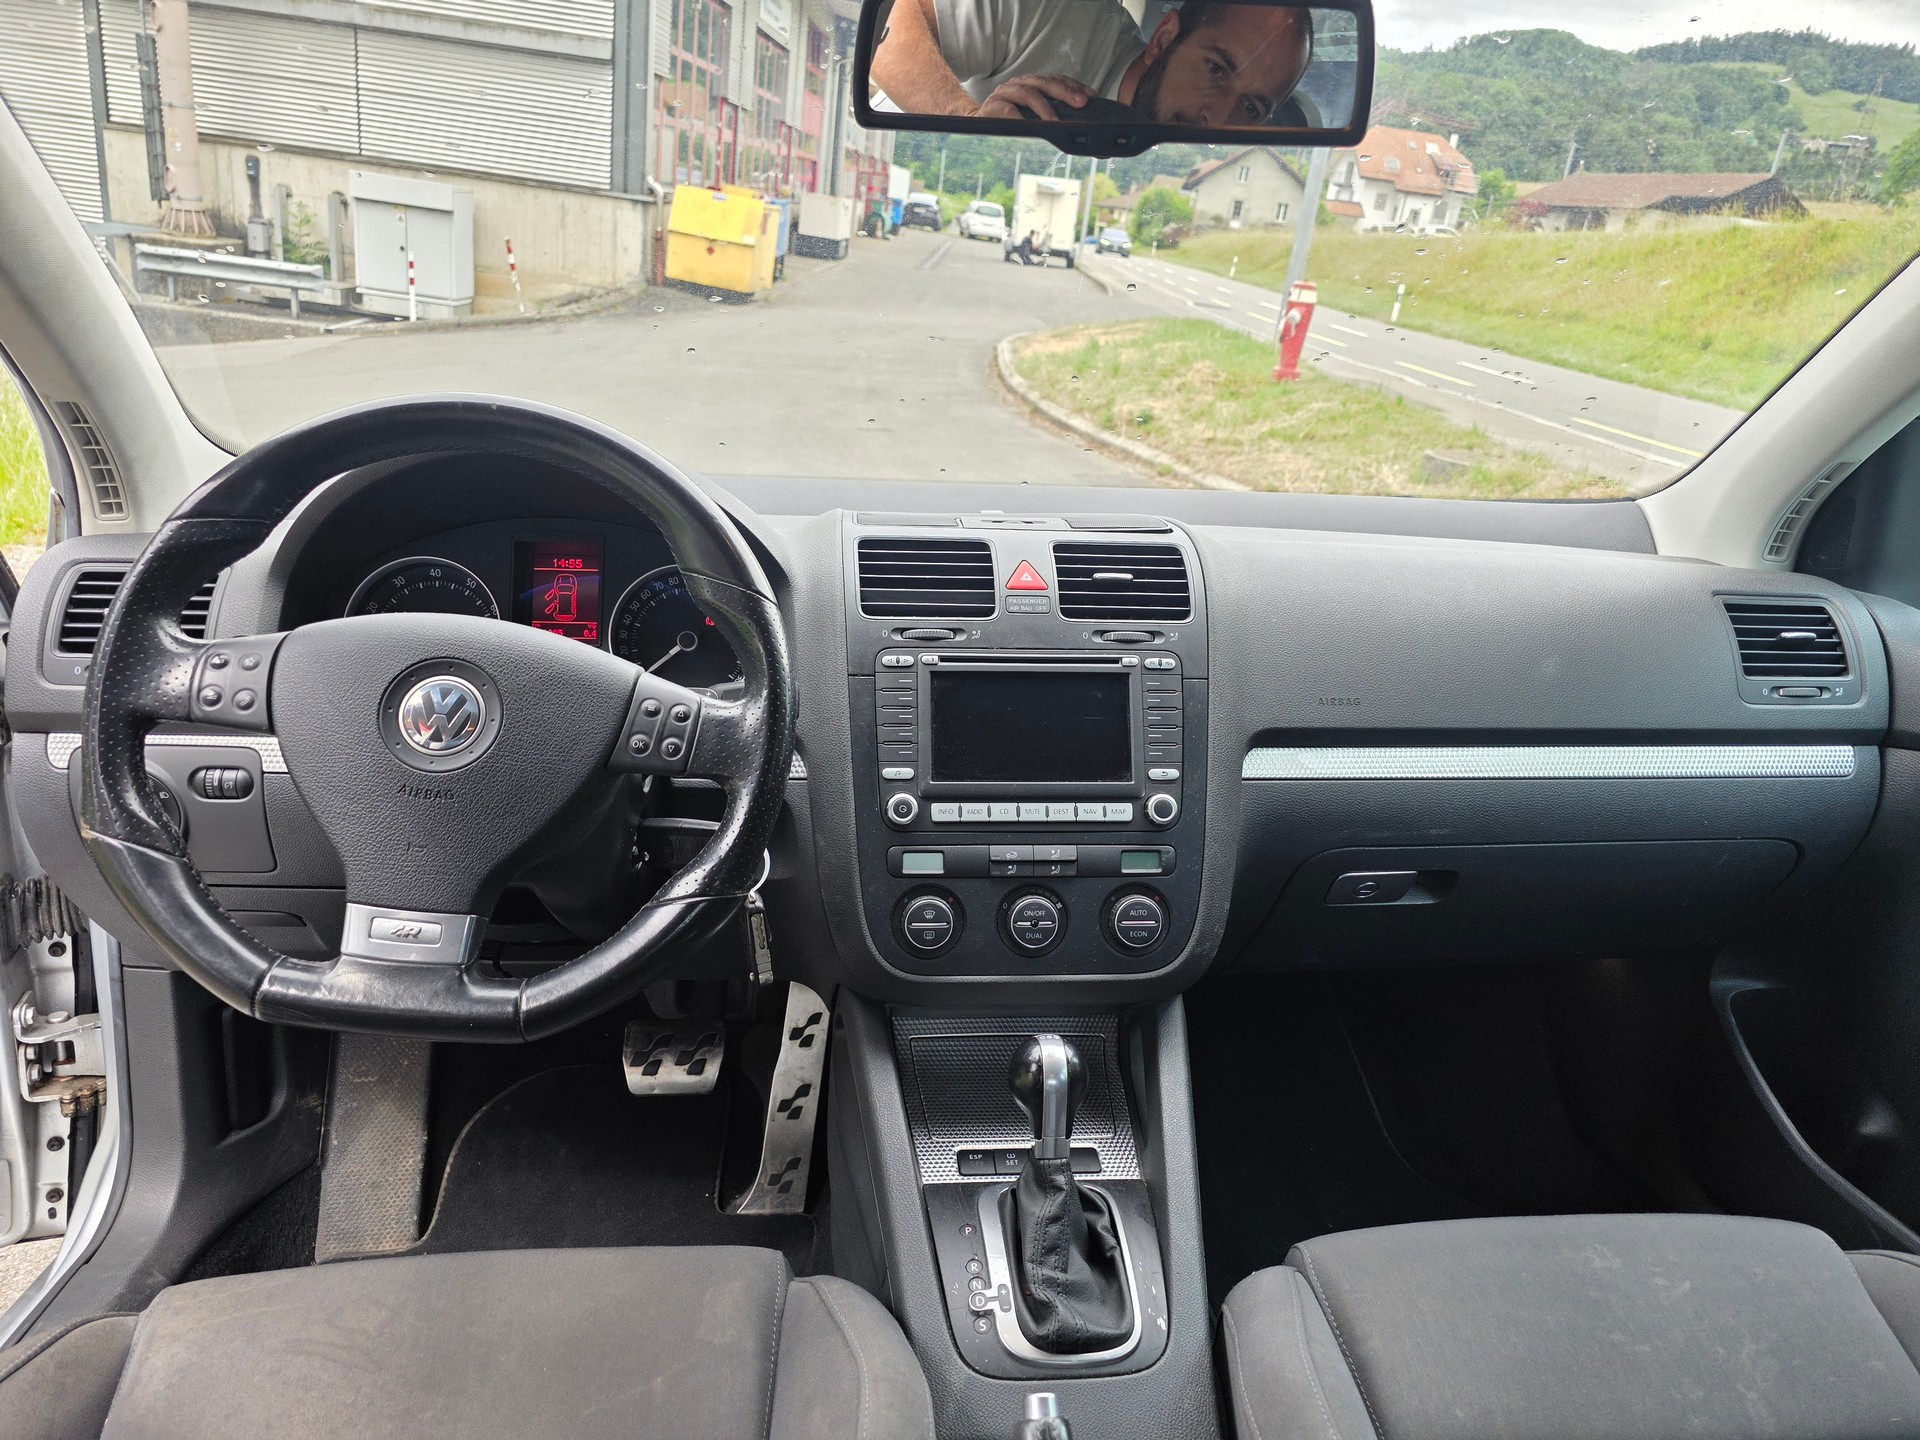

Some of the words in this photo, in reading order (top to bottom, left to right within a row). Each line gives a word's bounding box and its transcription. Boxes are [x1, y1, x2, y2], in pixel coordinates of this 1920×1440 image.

[552, 558, 583, 568] 14:55
[429, 568, 442, 578] 40
[392, 576, 406, 588] 30
[465, 577, 477, 589] 50
[668, 576, 679, 586] 80
[653, 581, 665, 592] 70
[640, 589, 652, 600] 60
[366, 601, 379, 614] 20
[629, 600, 641, 612] 50
[624, 614, 633, 626] 40
[583, 629, 597, 638] 0.4
[619, 629, 628, 640] 30
[881, 629, 889, 638] 0
[1082, 631, 1089, 640] 0
[620, 645, 629, 656] 20
[74, 666, 82, 675] 0
[1762, 688, 1768, 696] 0
[1319, 697, 1360, 706] AIRBAG
[632, 740, 645, 749] OK
[397, 784, 455, 801] AIRBAG
[1023, 909, 1046, 918] ON/OFF
[1129, 909, 1148, 917] AUTO
[1025, 931, 1043, 940] DUAL
[1129, 930, 1148, 938] ECON
[965, 1226, 972, 1235] P
[971, 1263, 978, 1272] R
[973, 1280, 982, 1290] N
[975, 1296, 984, 1307] D
[979, 1319, 987, 1332] S
